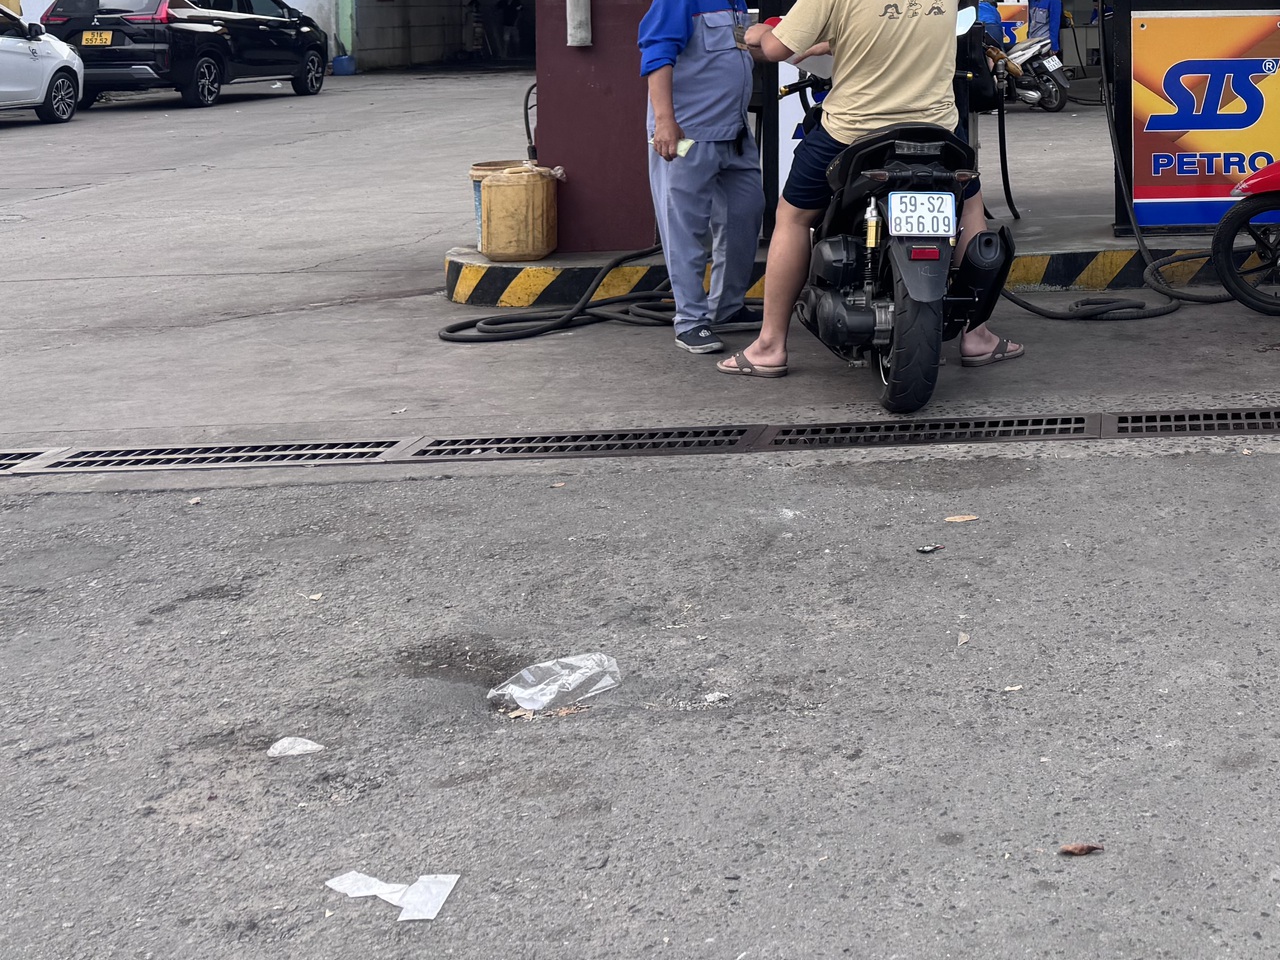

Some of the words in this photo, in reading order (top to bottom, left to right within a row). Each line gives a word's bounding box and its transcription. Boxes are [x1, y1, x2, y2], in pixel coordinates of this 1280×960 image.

[1152, 151, 1276, 176] PETRO
[900, 195, 945, 214] 59-S2
[894, 215, 951, 233] 856.09
